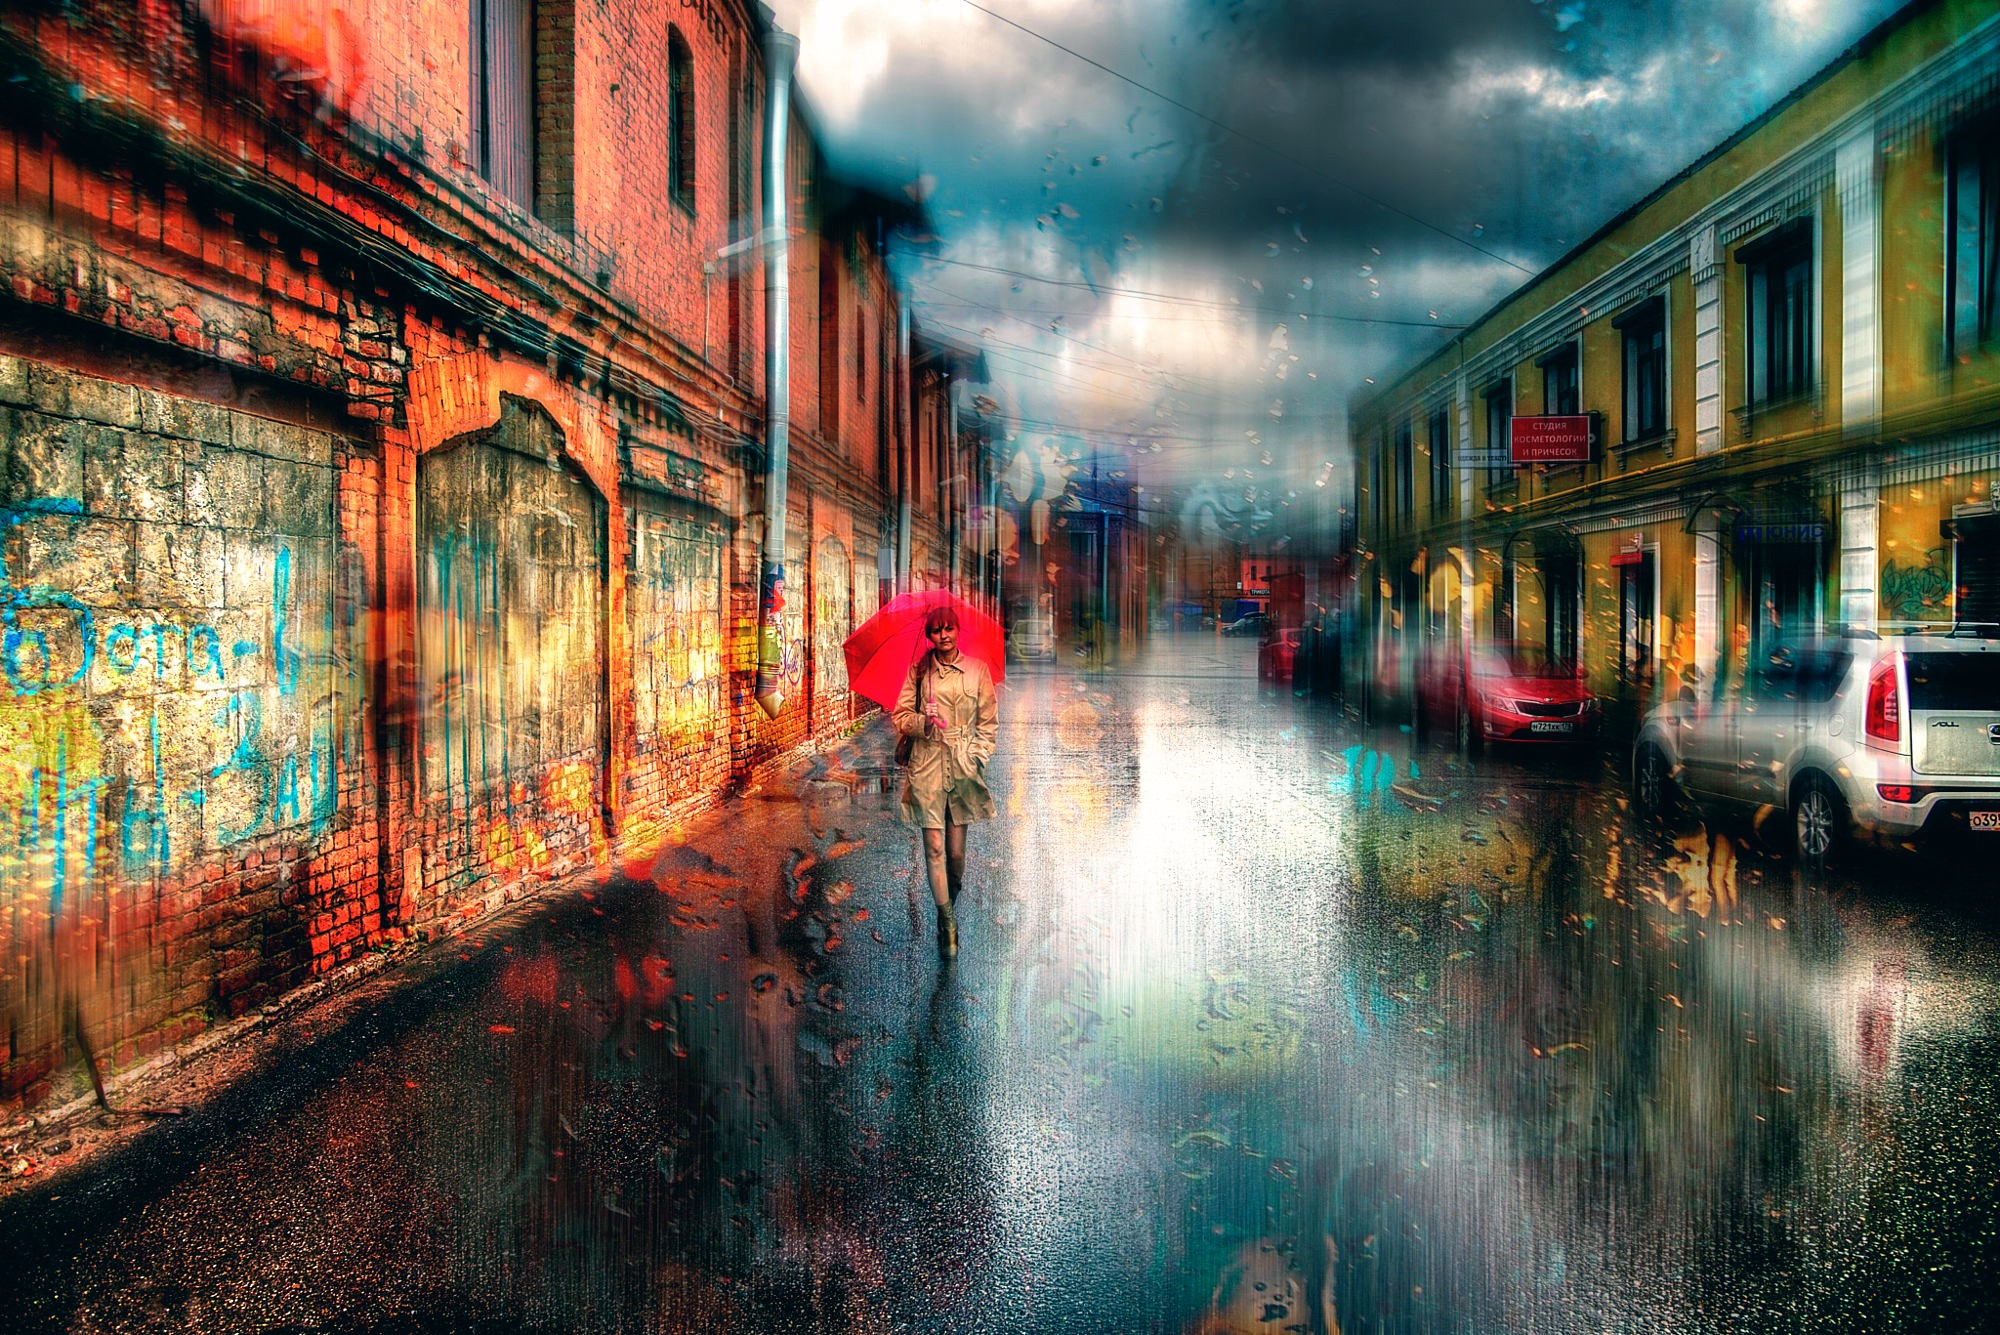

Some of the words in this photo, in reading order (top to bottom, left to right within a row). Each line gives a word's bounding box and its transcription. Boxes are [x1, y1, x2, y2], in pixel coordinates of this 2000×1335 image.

[1532, 422, 1567, 431] СТУДИЯ
[1514, 434, 1586, 443] КОСМЕТОЛОГИИ
[1522, 448, 1528, 456] И
[1531, 448, 1577, 456] ПРИЧЕСОК
